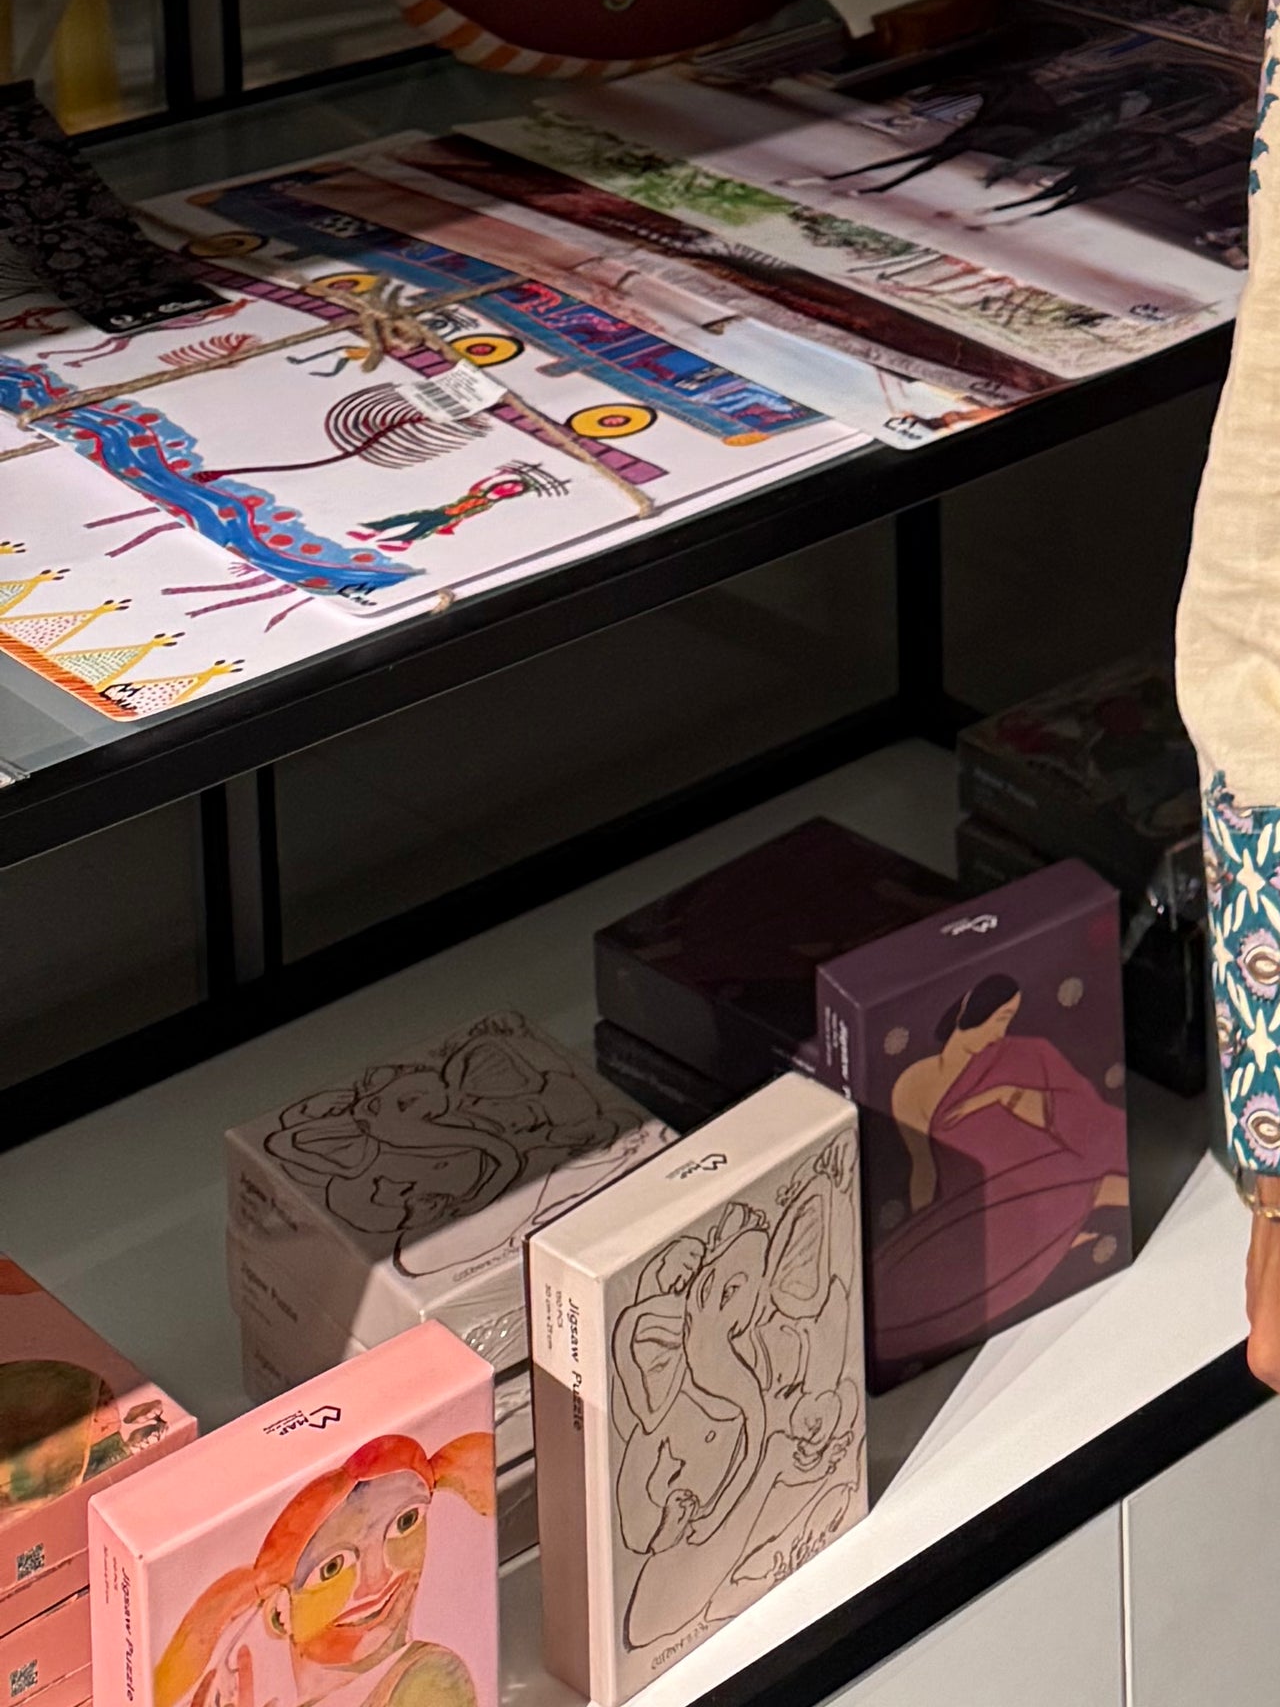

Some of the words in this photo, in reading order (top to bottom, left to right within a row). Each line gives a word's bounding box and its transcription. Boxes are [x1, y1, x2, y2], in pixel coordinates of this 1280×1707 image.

[566, 1297, 580, 1363] Jigsaw
[571, 1370, 583, 1432] Puzzle
[121, 1567, 132, 1636] Jigsaw
[126, 1638, 135, 1702] Puzzle
